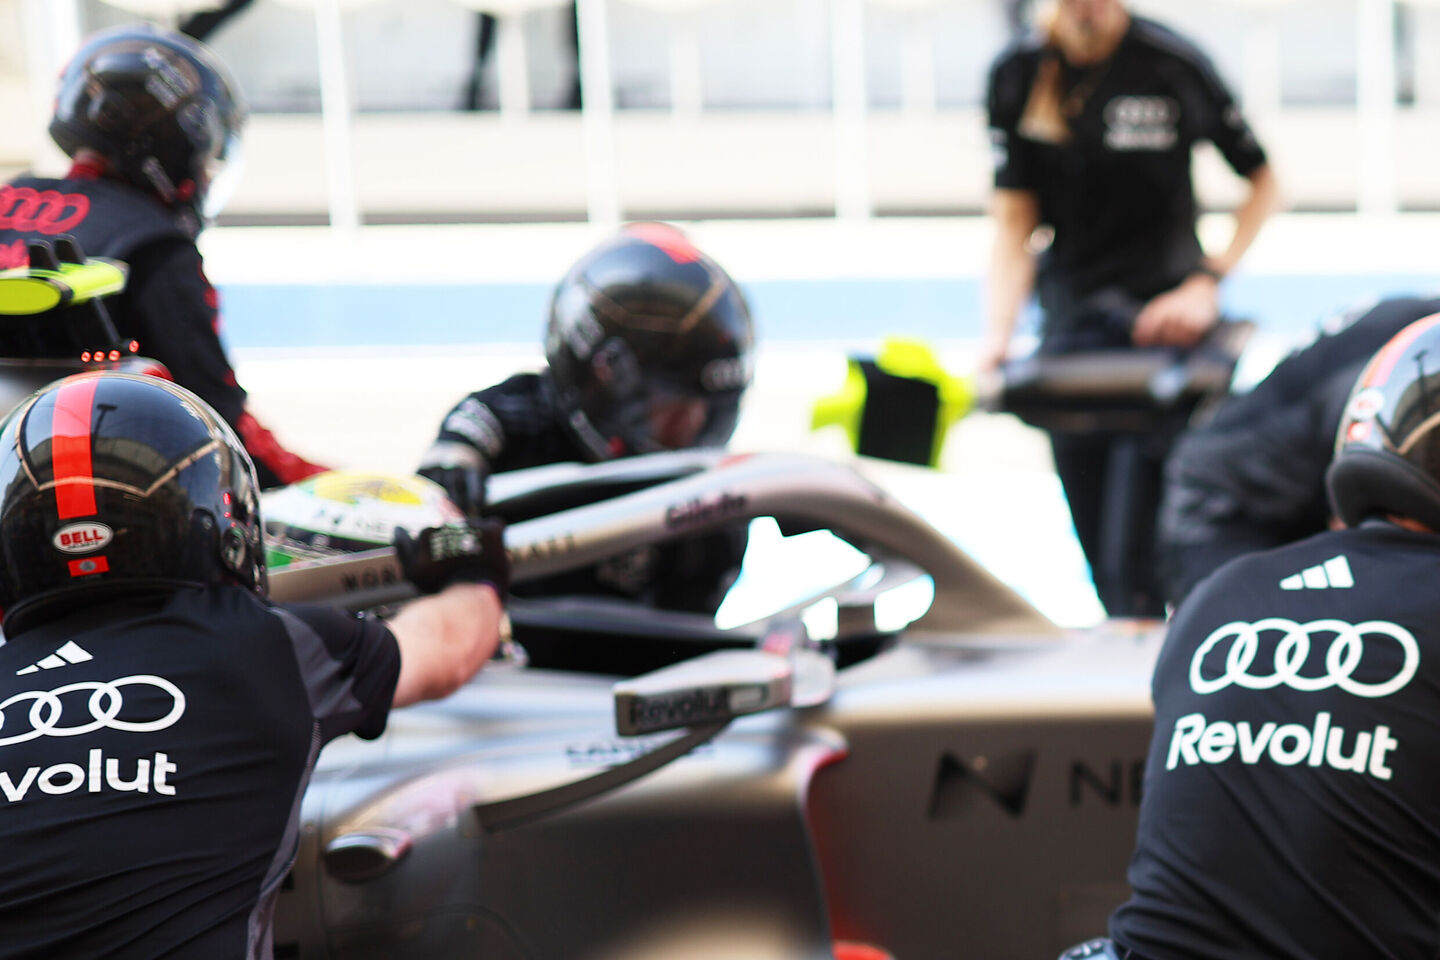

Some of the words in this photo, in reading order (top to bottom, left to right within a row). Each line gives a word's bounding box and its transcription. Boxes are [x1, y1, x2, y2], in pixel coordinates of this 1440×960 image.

[60, 528, 103, 546] BELL
[1166, 711, 1398, 780] Revolut
[0, 748, 177, 802] volut
